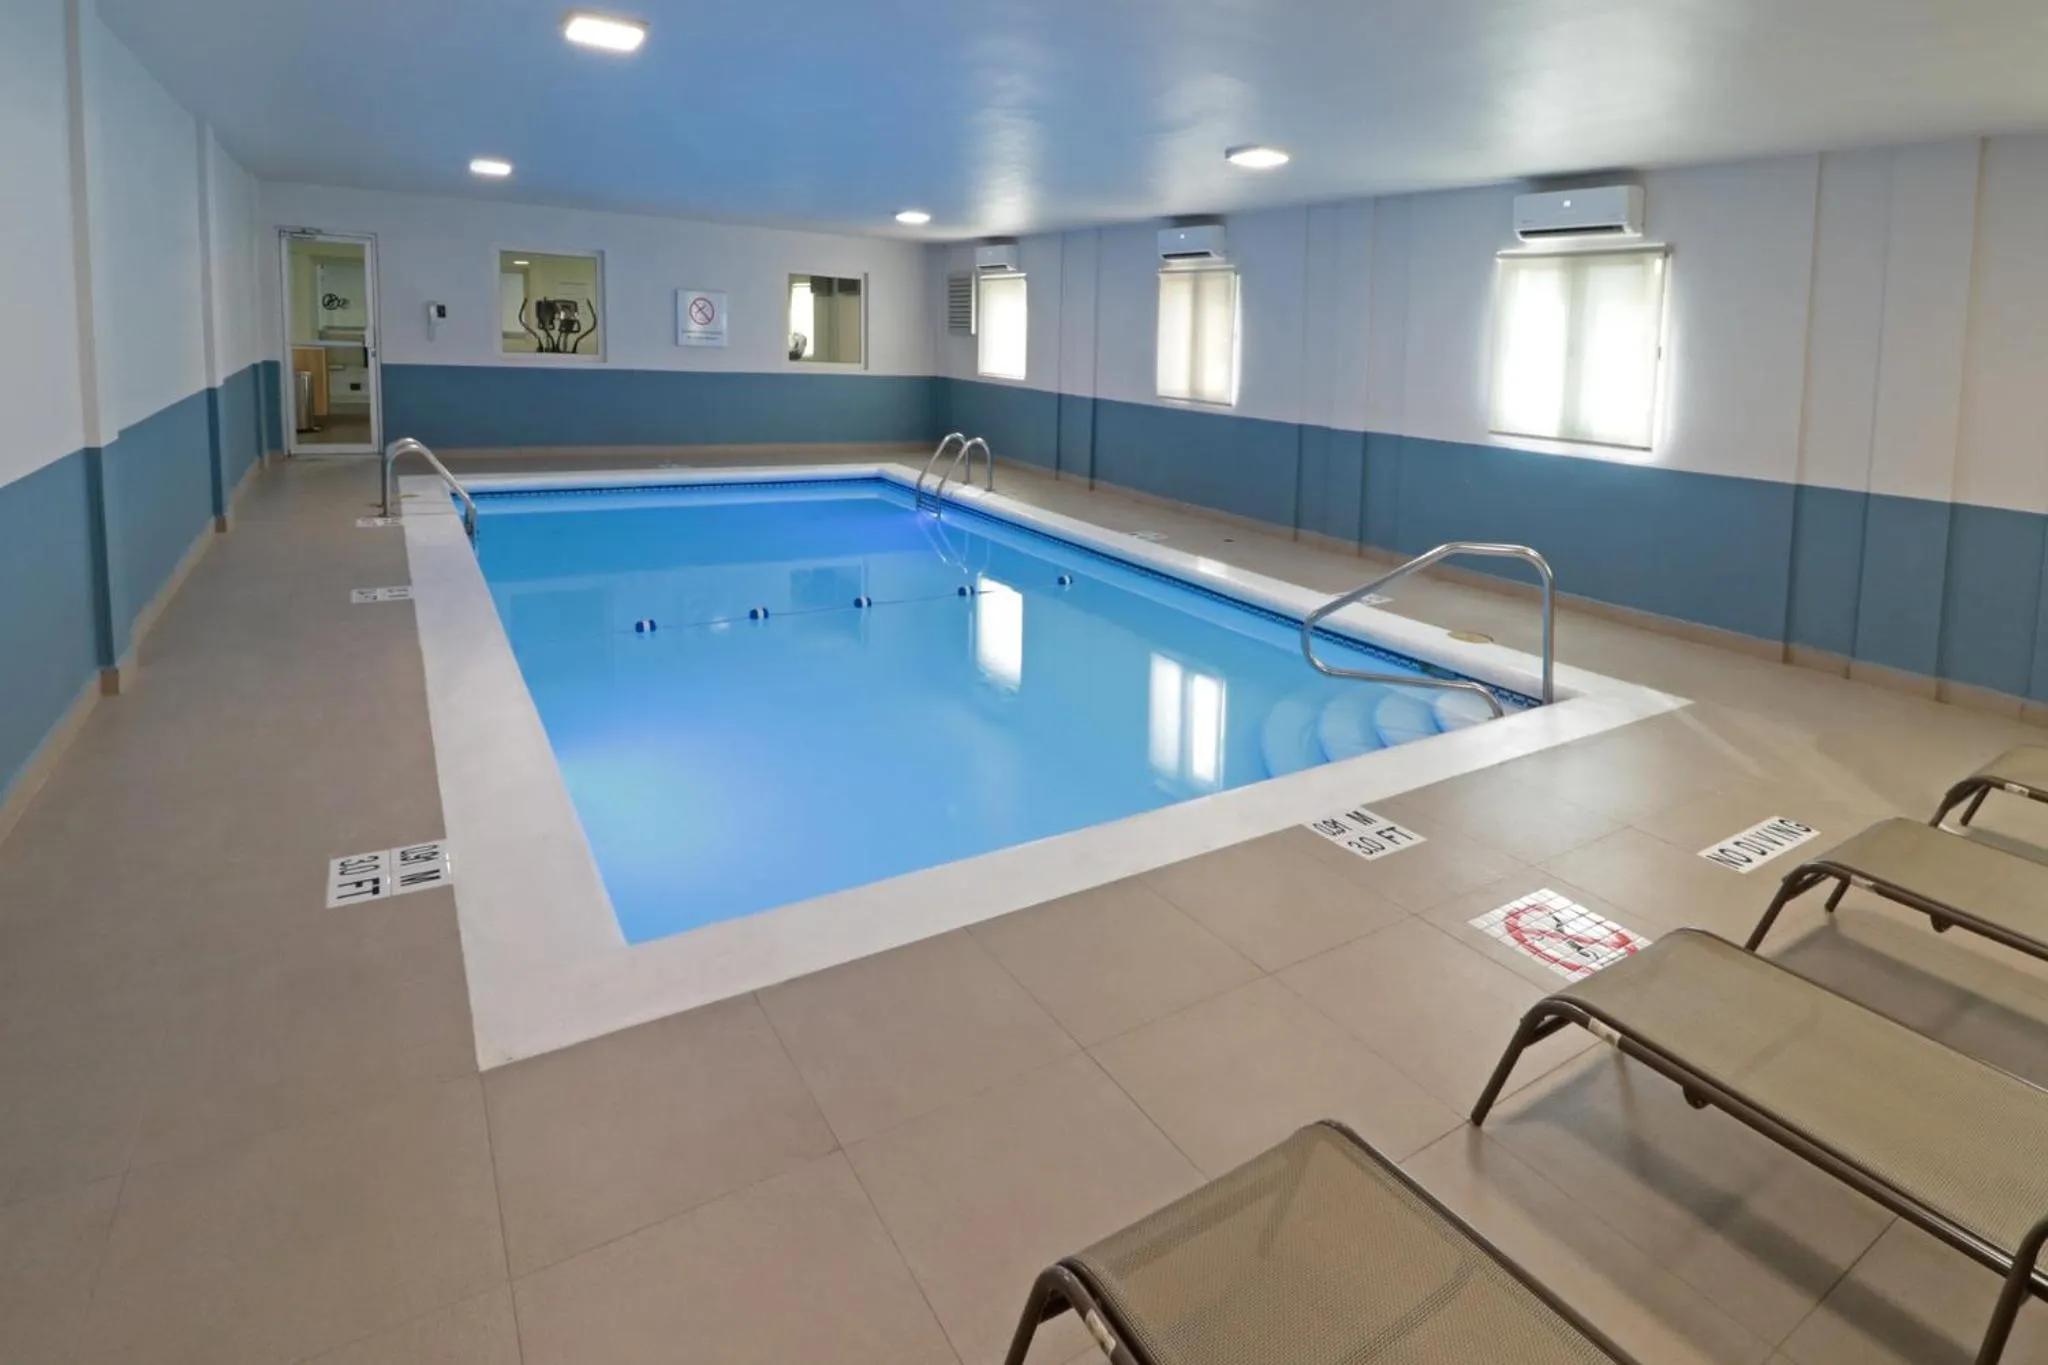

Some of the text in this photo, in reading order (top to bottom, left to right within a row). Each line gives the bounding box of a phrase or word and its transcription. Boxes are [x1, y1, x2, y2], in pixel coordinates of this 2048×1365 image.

[1345, 809, 1378, 826] M
[1347, 826, 1414, 856] 3.0 FT
[1705, 818, 1813, 871] NO DIVING
[336, 855, 380, 900] 3.0 FT
[400, 868, 441, 887] M
